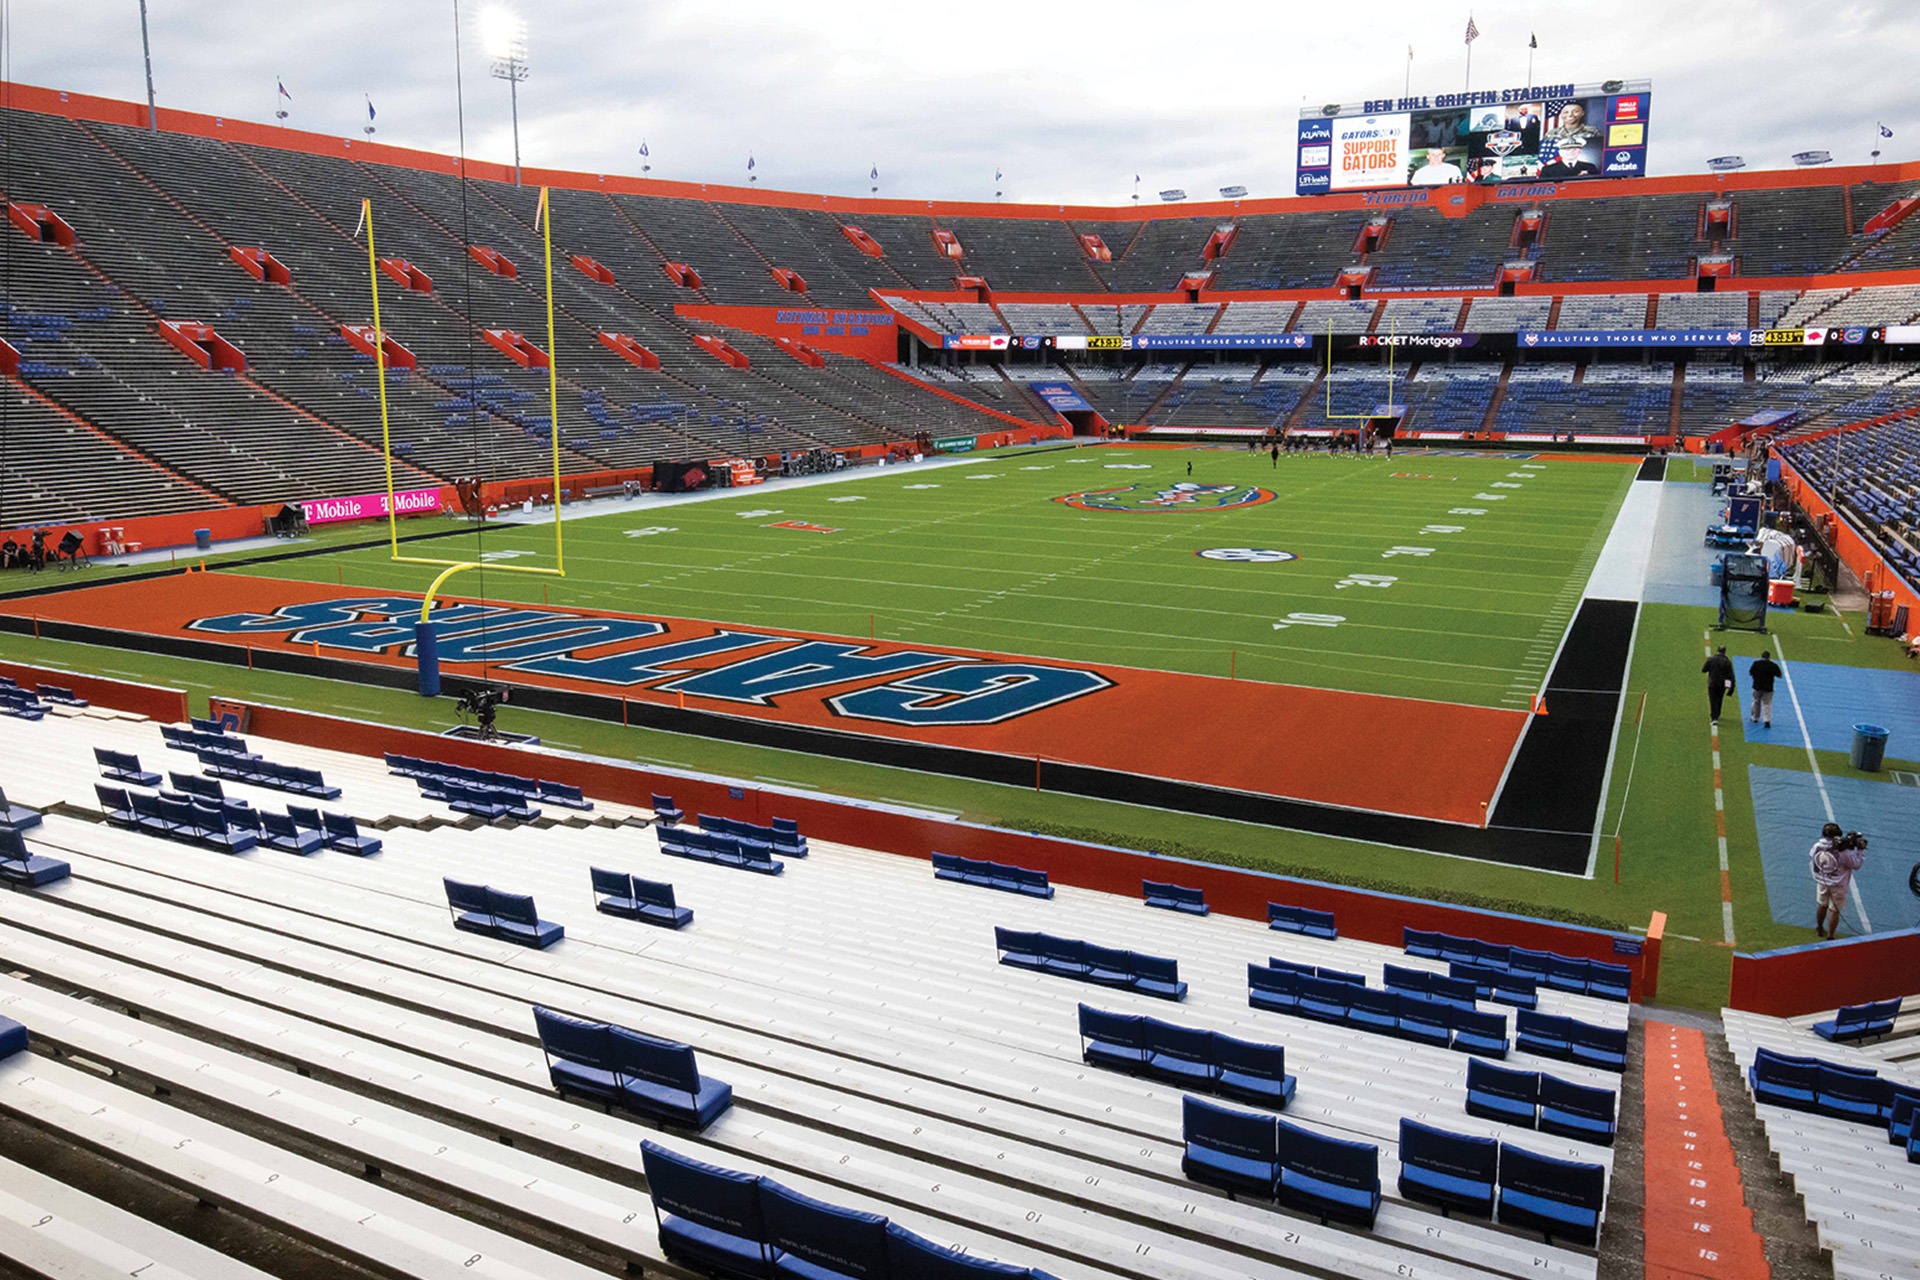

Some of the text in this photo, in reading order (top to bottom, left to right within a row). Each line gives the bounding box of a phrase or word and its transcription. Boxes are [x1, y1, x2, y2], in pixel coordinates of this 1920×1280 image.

[1364, 84, 1575, 113] BEN HILL GRIFFIN STADIUM
[1341, 129, 1379, 140] GATORS
[1343, 139, 1397, 155] SUPPORT
[1343, 153, 1397, 171] GATORS
[1497, 186, 1557, 198] GATORS
[1366, 192, 1428, 204] FLORIDA
[776, 311, 829, 324] NATIONAL
[1765, 332, 1793, 342] 43:33
[1831, 332, 1838, 340] 0
[1872, 331, 1879, 340] 0
[1359, 335, 1462, 348] ROCKET Mortgage
[316, 501, 361, 519] Mobile
[1276, 612, 1347, 628] 10
[183, 596, 1119, 727] GATORS
[173, 1139, 191, 1150] 5
[1684, 1143, 1695, 1151] 11
[1688, 1161, 1703, 1170] 12
[524, 1179, 538, 1189] 7
[1085, 1176, 1100, 1186] 10
[1690, 1178, 1707, 1189] 13
[1689, 1197, 1707, 1208] 14
[1184, 1204, 1196, 1214] 11
[32, 1216, 53, 1227] 6
[358, 1214, 376, 1225] 7
[623, 1213, 637, 1224] 8
[1025, 1211, 1042, 1222] 10
[1427, 1227, 1441, 1237] 13
[1693, 1222, 1711, 1233] 15
[1284, 1232, 1300, 1244] 12
[1136, 1244, 1150, 1255] 11
[1699, 1248, 1719, 1261] 16
[464, 1254, 482, 1267] 8
[1534, 1257, 1548, 1268] 14
[130, 1263, 154, 1277] 7
[1398, 1264, 1414, 1278] 13
